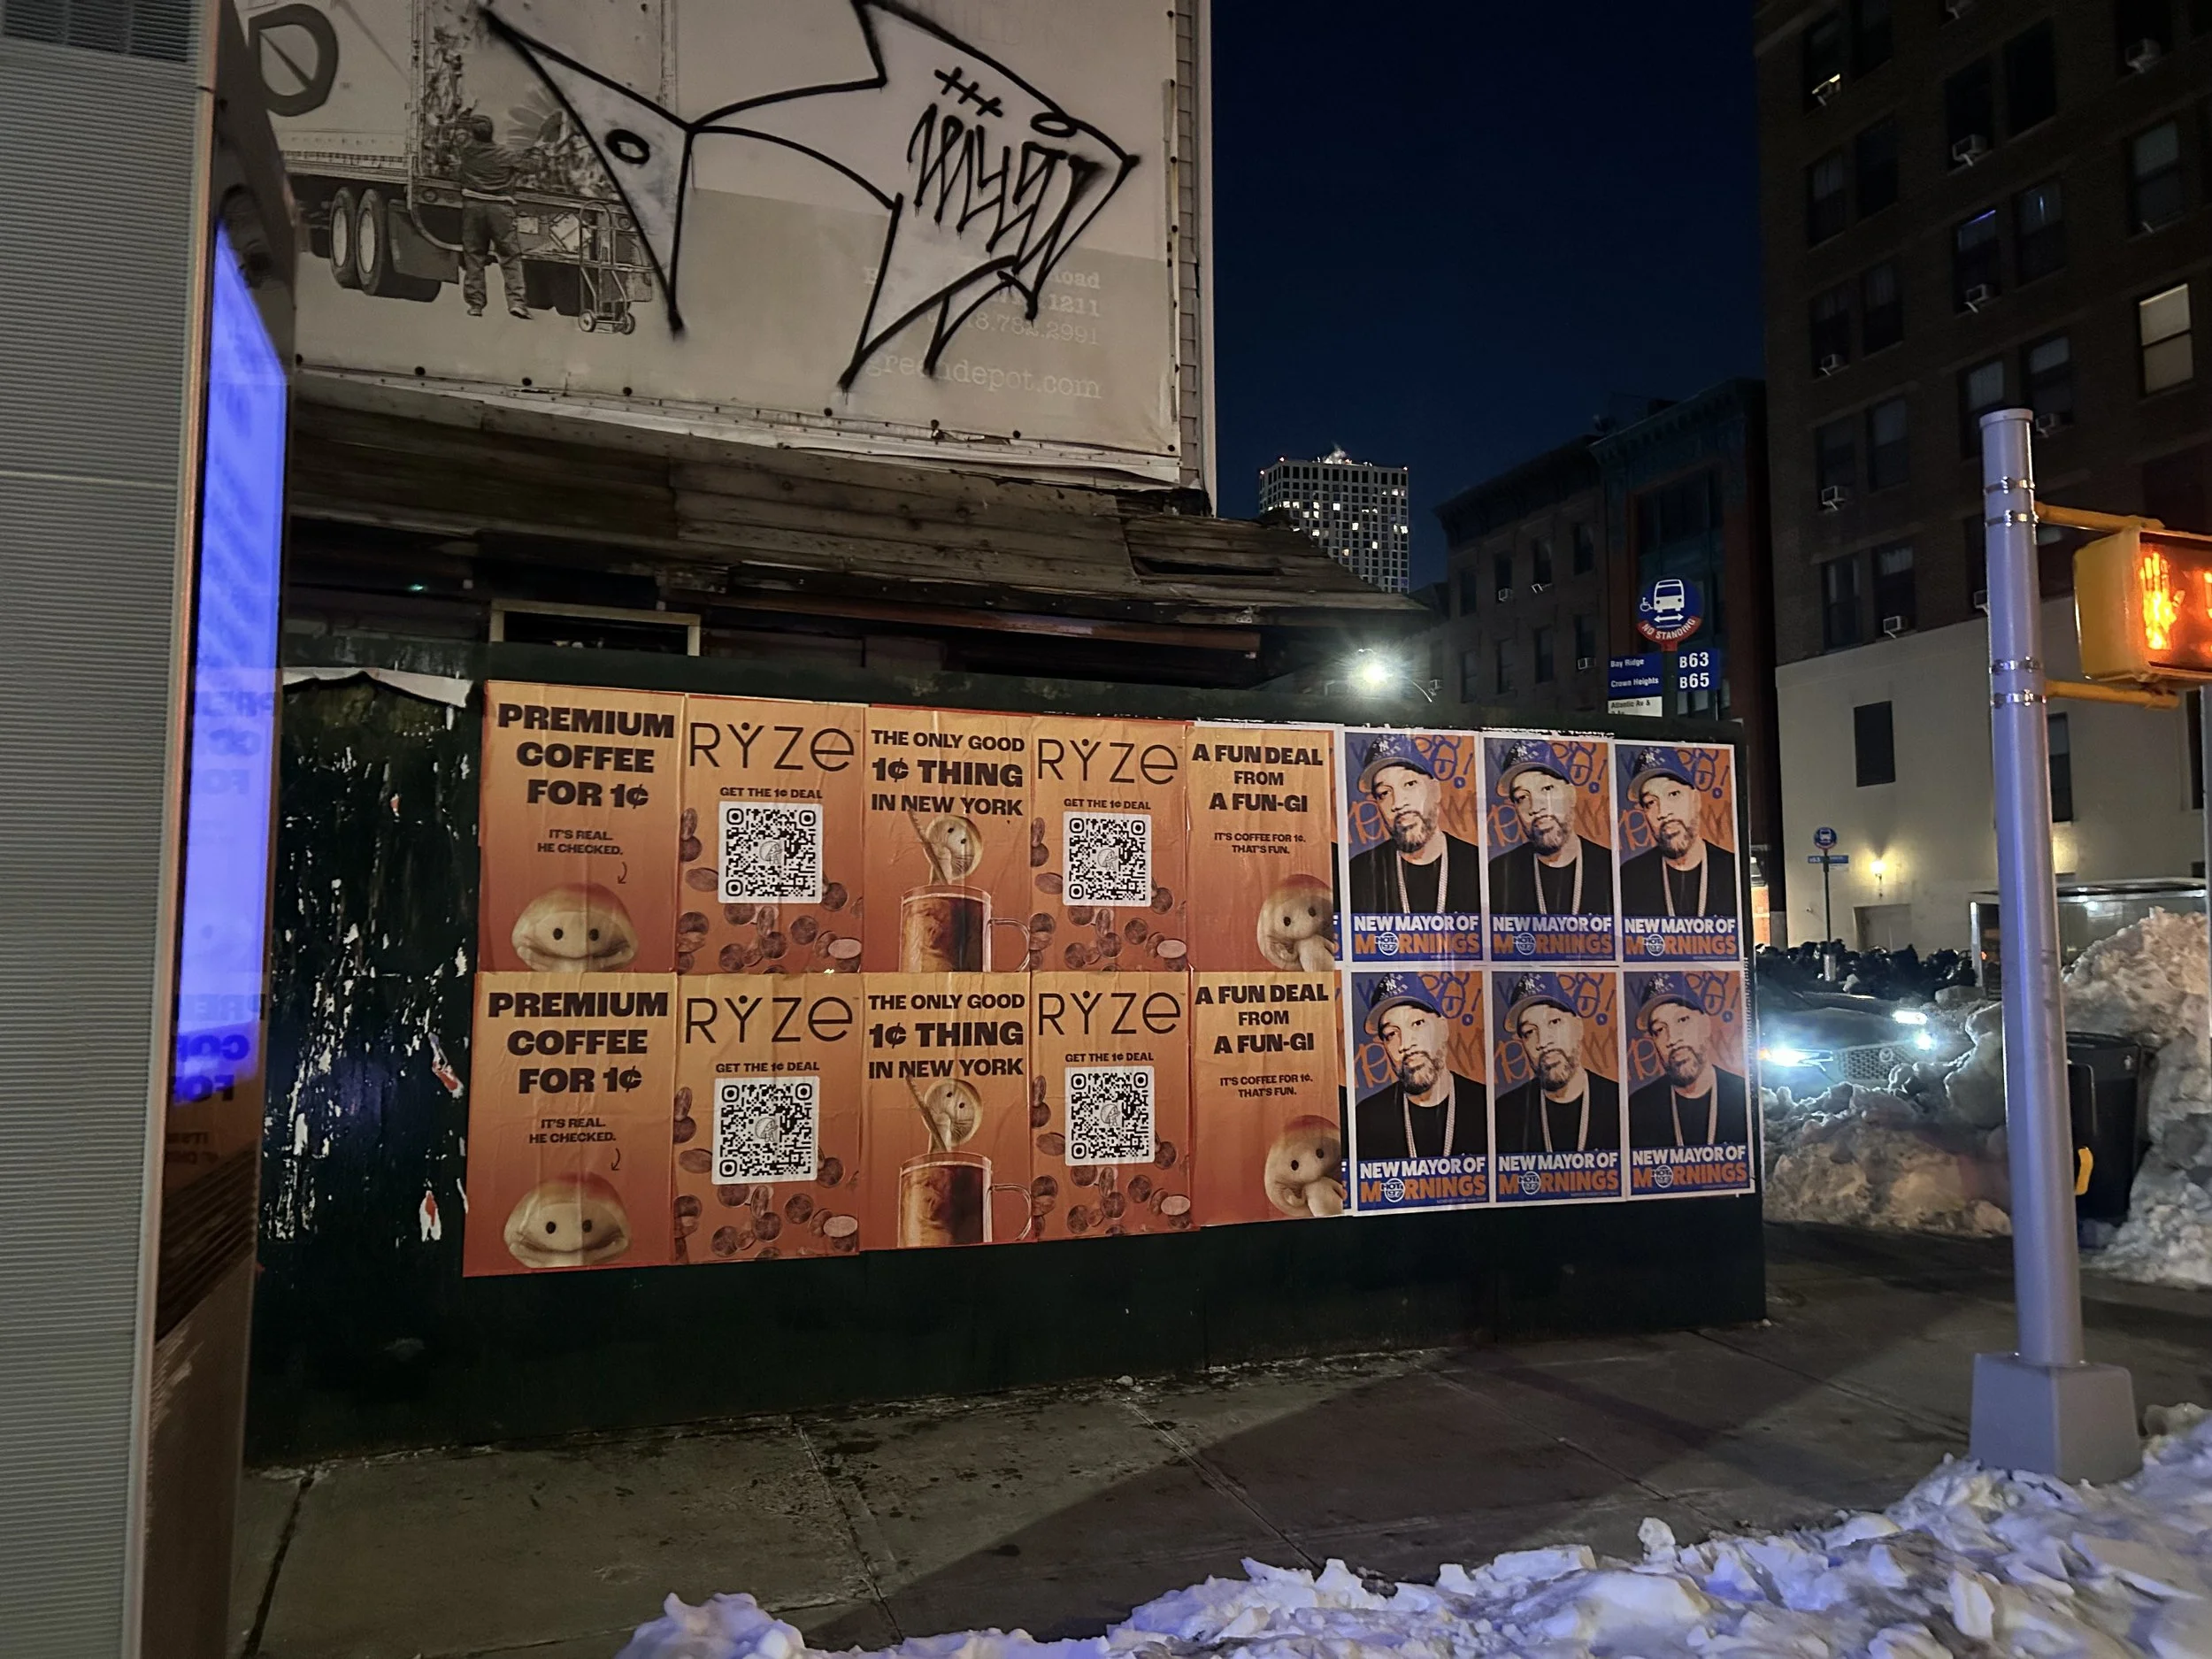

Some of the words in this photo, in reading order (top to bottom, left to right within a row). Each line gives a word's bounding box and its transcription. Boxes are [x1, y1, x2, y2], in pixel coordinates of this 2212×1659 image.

[1641, 622, 1653, 635] NO
[1655, 618, 1695, 641] STANDING
[1624, 658, 1644, 667] Ridge
[1679, 651, 1709, 669] B63
[1633, 677, 1659, 686] Heights
[1679, 672, 1709, 688] B65
[497, 703, 674, 739] PREMIUM
[872, 730, 910, 747] THE
[913, 732, 963, 749] ONLY
[968, 733, 1025, 752] GOOD
[516, 741, 655, 773] COFFEE
[1192, 743, 1210, 761] A
[1215, 744, 1261, 764] FUN
[1265, 747, 1324, 765] DEAL
[872, 757, 910, 783] 1¢
[916, 759, 1024, 787] THING
[1234, 770, 1284, 786] FROM
[526, 779, 607, 807] FOR
[611, 784, 649, 810] 1¢
[719, 787, 744, 798] GET
[747, 787, 771, 798] THE
[773, 788, 788, 798] 1¢
[790, 788, 823, 799] DEAL
[872, 794, 896, 811] IN
[902, 795, 956, 814] NEW
[959, 796, 1023, 817] YORK
[1064, 798, 1085, 809] GET
[1087, 798, 1107, 809] THE
[1109, 799, 1122, 810] 1¢
[1124, 800, 1151, 810] DEAL
[1210, 792, 1226, 810] A
[1232, 793, 1308, 813] FUN-GI
[549, 829, 575, 841] IT'S
[576, 829, 612, 841] REAL.
[1214, 832, 1233, 842] IT'S
[1234, 833, 1271, 843] COFFEE
[1271, 833, 1292, 843] FOR
[537, 843, 556, 854] HE
[557, 843, 623, 855] CHECKED.
[1232, 844, 1265, 855] THAT'S
[1267, 845, 1291, 855] FUN.
[1354, 915, 1394, 932] NEW
[1395, 915, 1455, 932] MAYOR
[1455, 915, 1479, 932] OF
[1493, 917, 1531, 932] NEW
[1532, 917, 1589, 932] MAYOR
[1590, 917, 1611, 932] OF
[1624, 918, 1660, 933] NEW
[1661, 918, 1715, 933] MAYOR
[1716, 918, 1736, 933] OF
[868, 995, 908, 1010] THE
[911, 994, 964, 1010] ONLY
[966, 993, 1025, 1010] GOOD
[1194, 987, 1215, 1005] A
[1218, 985, 1266, 1004] FUN
[1270, 983, 1329, 1002] DEAL
[488, 992, 668, 1018] PREMIUM
[1239, 1010, 1290, 1026] FROM
[507, 1029, 648, 1056] COFFEE
[868, 1022, 908, 1049] 1¢
[914, 1021, 1024, 1048] THING
[1213, 1036, 1231, 1055] A
[1237, 1034, 1314, 1054] FUN-GI
[1064, 1053, 1087, 1064] GET
[1088, 1052, 1110, 1064] THE
[1111, 1052, 1125, 1063] 1¢
[1126, 1051, 1155, 1063] DEAL
[715, 1063, 741, 1073] GET
[743, 1062, 768, 1073] THE
[770, 1062, 785, 1073] 1¢
[787, 1061, 820, 1072] DEAL
[868, 1060, 895, 1079] IN
[898, 1059, 954, 1079] NEW
[958, 1057, 1024, 1078] YORK
[518, 1067, 595, 1094] FOR
[602, 1065, 642, 1094] 1¢
[1219, 1076, 1240, 1087] IT'S
[1240, 1075, 1277, 1086] COFFEE
[1278, 1074, 1299, 1085] FOR
[1238, 1087, 1272, 1098] THAT'S
[1273, 1087, 1298, 1097] FUN.
[541, 1118, 566, 1130] IT'S
[567, 1118, 607, 1129] REAL.
[529, 1133, 549, 1144] HE
[549, 1132, 617, 1143] CHECKED.
[1499, 1155, 1536, 1171] NEW
[1538, 1153, 1595, 1170] MAYOR
[1596, 1152, 1618, 1168] OF
[1632, 1148, 1669, 1165] NEW
[1670, 1147, 1724, 1164] MAYOR
[1725, 1145, 1747, 1161] OF
[1360, 1161, 1401, 1179] NEW
[1402, 1158, 1463, 1177] MAYOR
[1463, 1156, 1486, 1173] OF
